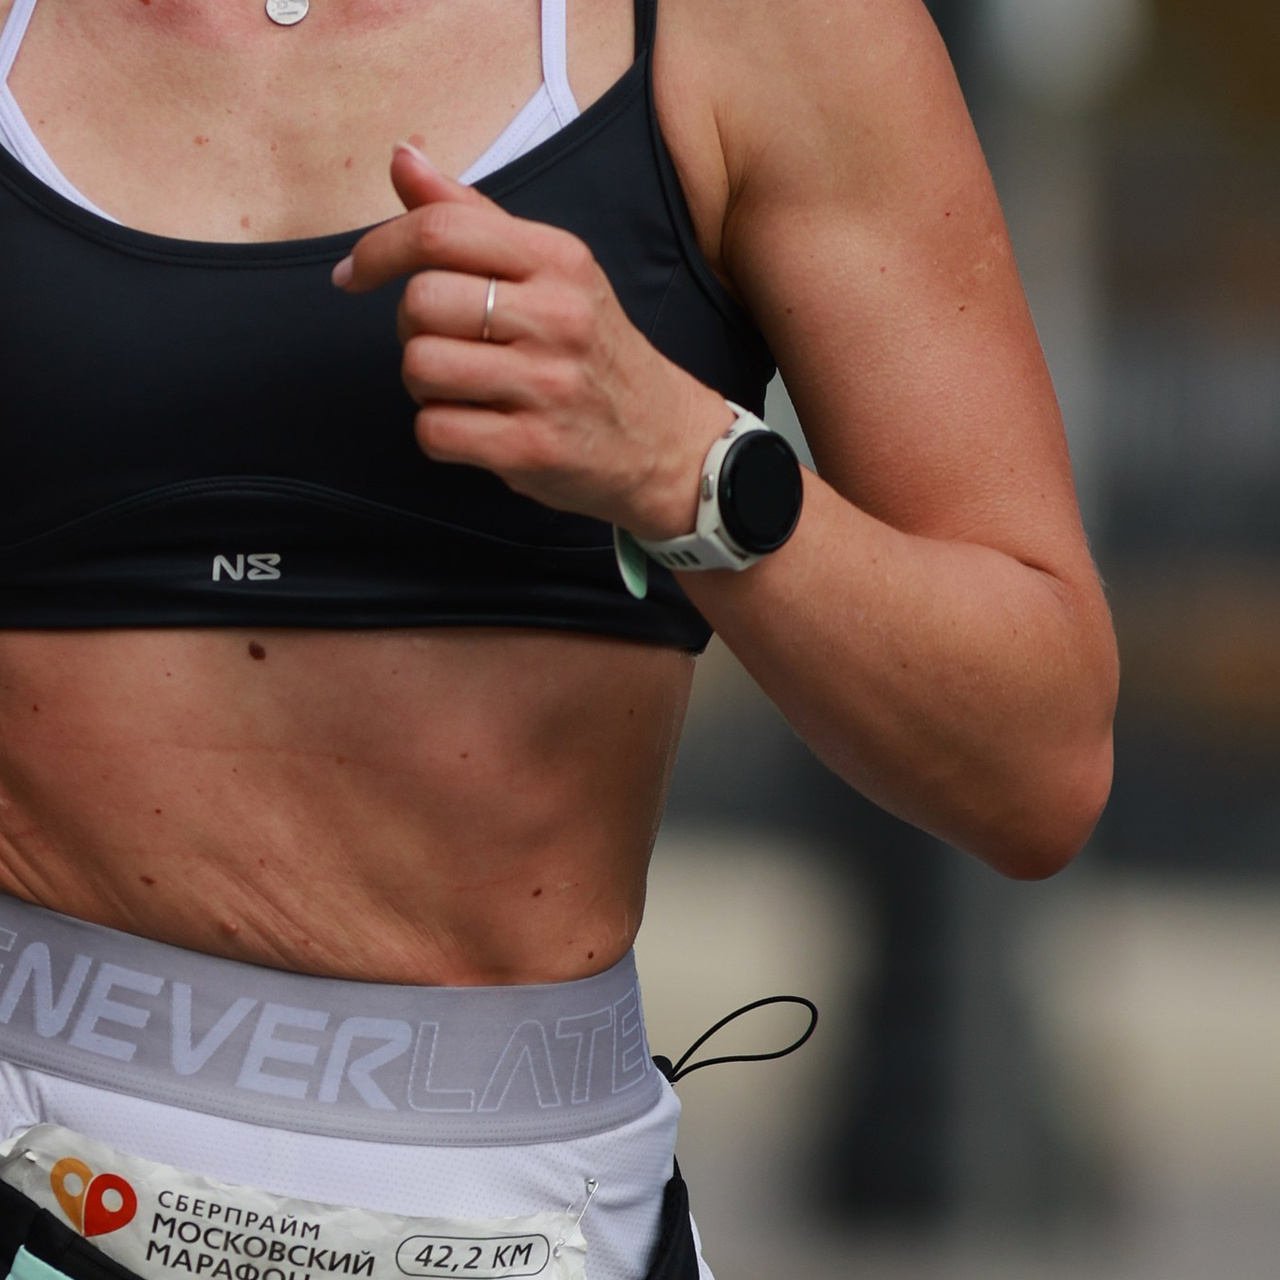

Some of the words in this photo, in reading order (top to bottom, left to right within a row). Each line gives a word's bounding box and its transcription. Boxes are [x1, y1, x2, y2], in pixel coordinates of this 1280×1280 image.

[157, 1190, 321, 1241] СБЕРПРАЙМ
[151, 1212, 375, 1277] МОСКОВСКИЙ
[414, 1244, 483, 1272] 42,2
